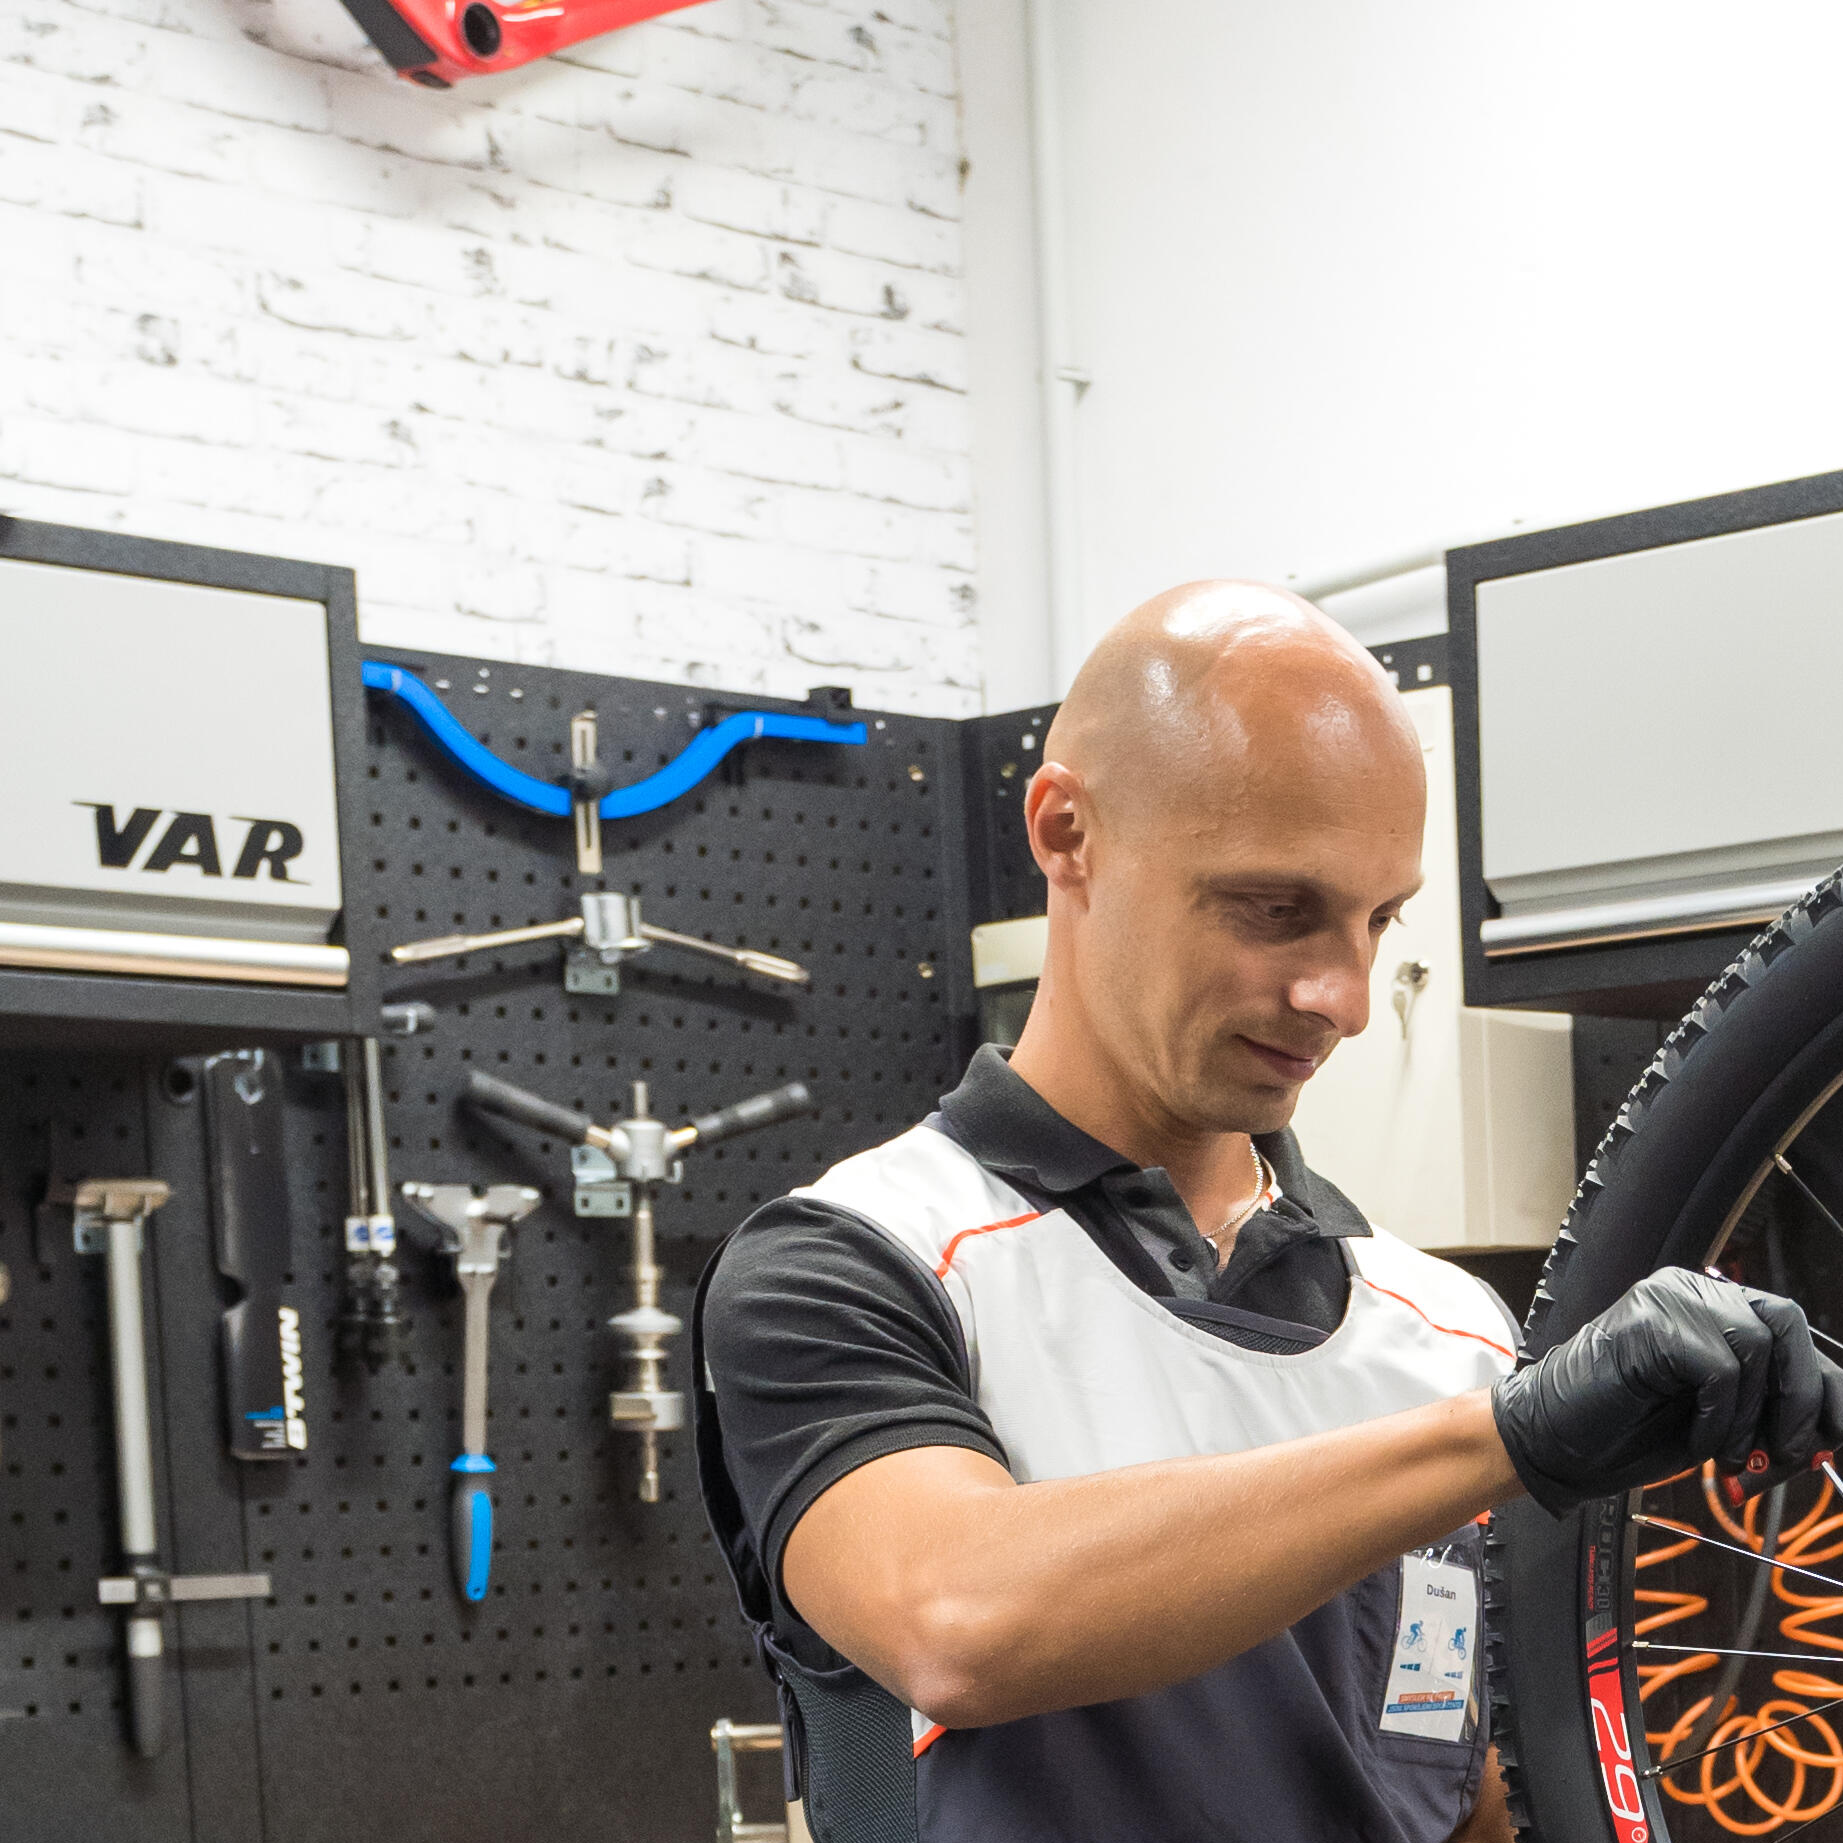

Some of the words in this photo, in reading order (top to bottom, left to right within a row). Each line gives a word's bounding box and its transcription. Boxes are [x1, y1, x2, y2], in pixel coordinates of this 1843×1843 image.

[74, 801, 311, 884] VAR
[1426, 1583, 1457, 1600] Dušan
[1590, 1697, 1645, 1822] 29
